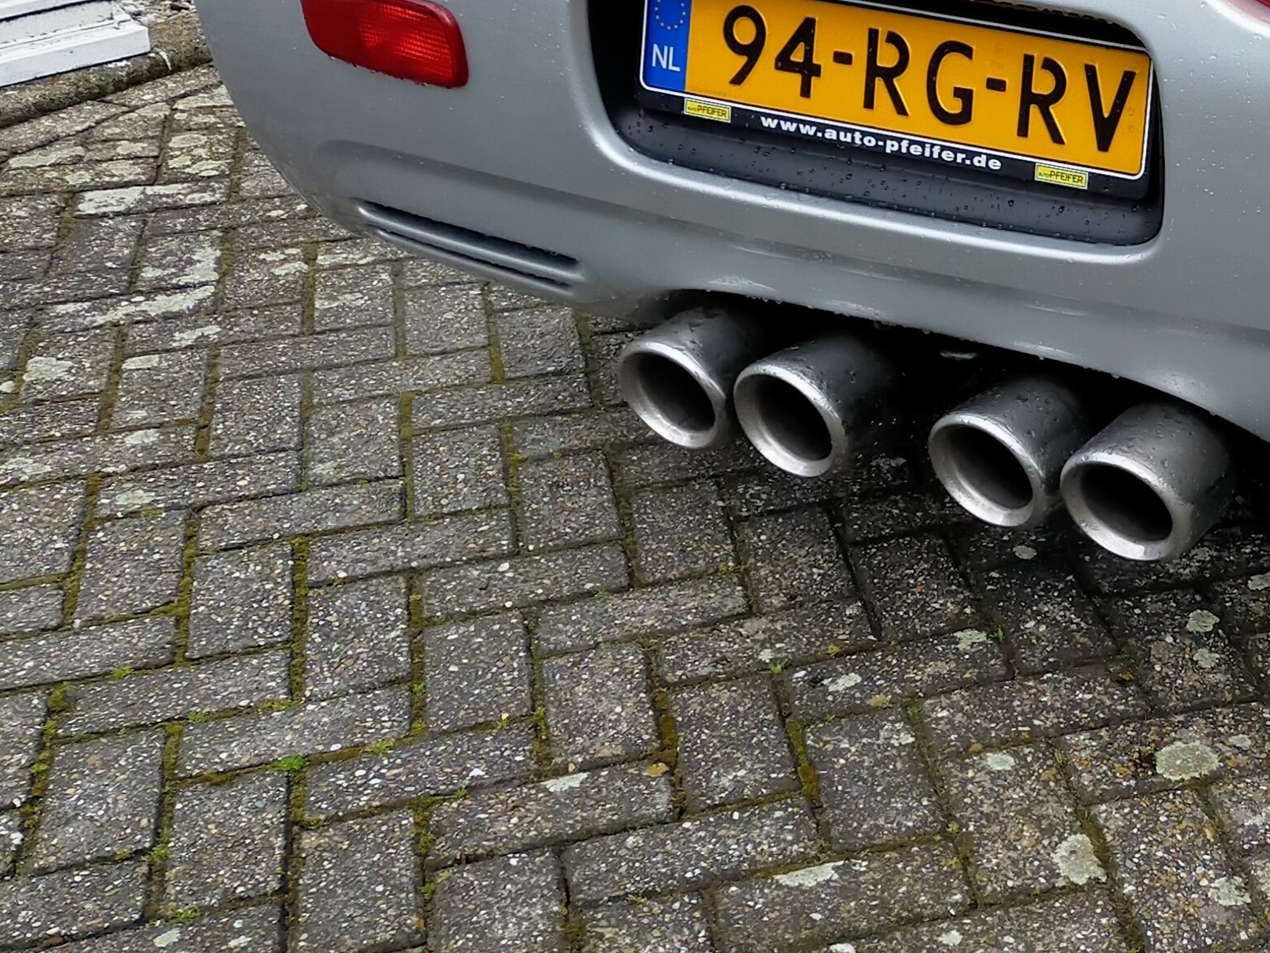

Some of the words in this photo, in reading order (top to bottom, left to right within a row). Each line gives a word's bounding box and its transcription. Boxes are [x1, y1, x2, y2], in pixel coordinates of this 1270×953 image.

[651, 43, 681, 72] NL
[722, 5, 1136, 153] 94-RG-RV
[760, 115, 1002, 171] www.auto-pfeifer.de
